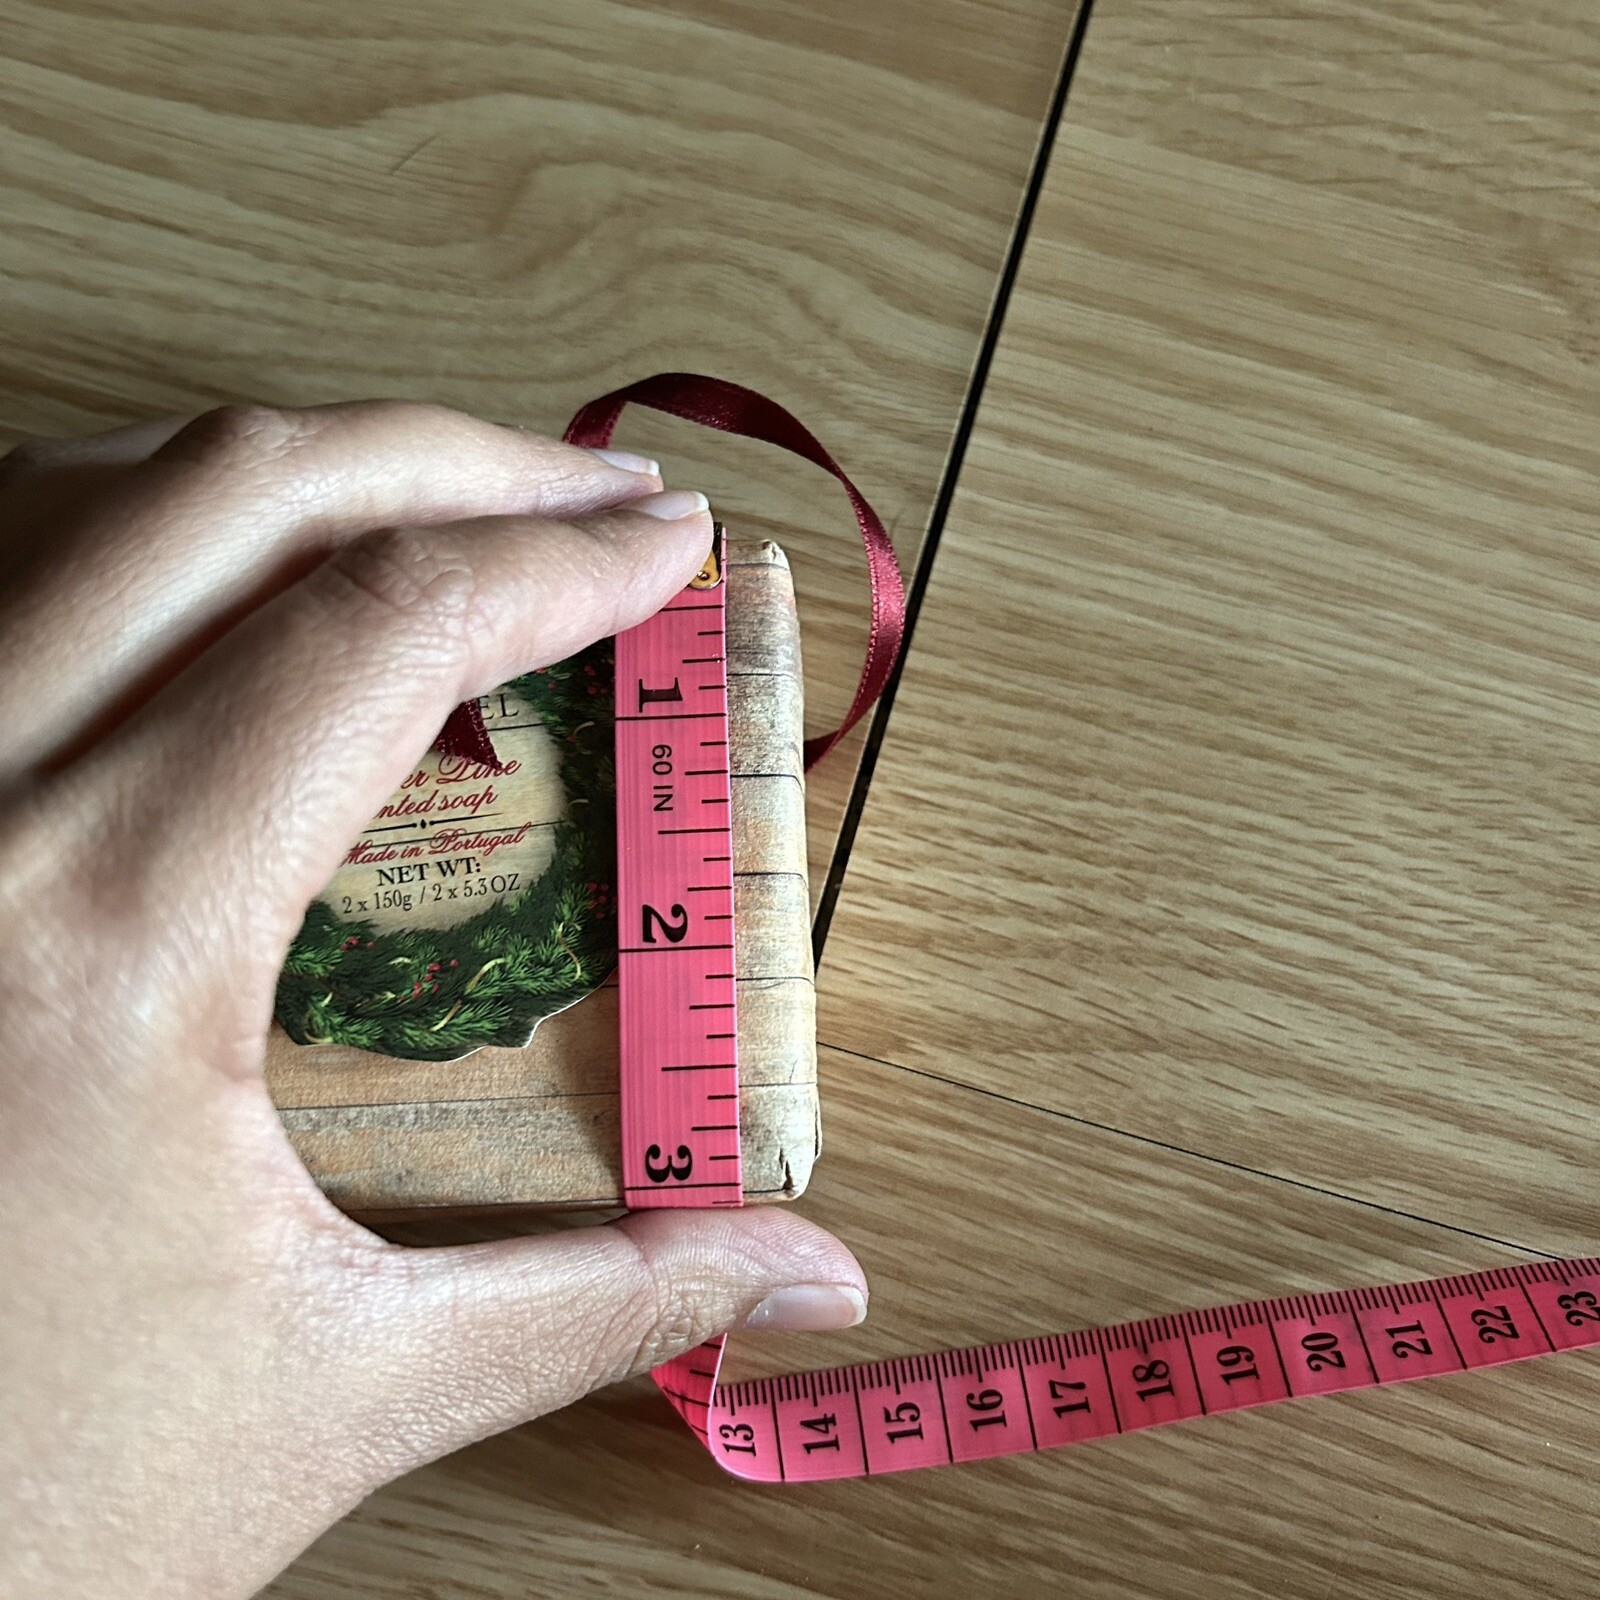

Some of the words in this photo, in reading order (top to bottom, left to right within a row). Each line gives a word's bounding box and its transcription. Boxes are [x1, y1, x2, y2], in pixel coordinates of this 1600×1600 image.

[637, 676, 683, 713] 1
[651, 743, 674, 777] 60
[438, 785, 498, 814] soap
[652, 784, 674, 813] IN
[400, 842, 425, 858] in
[427, 821, 532, 856] Portugal
[376, 863, 430, 887] NET
[436, 857, 481, 877] WT:
[341, 895, 353, 915] 2
[357, 901, 369, 911] x
[373, 889, 414, 911] 150g
[431, 882, 443, 903] 2
[447, 887, 459, 899] x
[641, 903, 688, 943] 2
[644, 1143, 693, 1183] 3
[1470, 1304, 1521, 1345] 22
[1556, 1290, 1600, 1329] 23
[1300, 1331, 1347, 1373] 20
[1384, 1319, 1434, 1360] 21
[1132, 1358, 1176, 1402] 18
[1215, 1345, 1261, 1387] 19
[965, 1388, 1009, 1432] 16
[1048, 1378, 1092, 1419] 17
[718, 1422, 757, 1458] 13
[798, 1413, 842, 1455] 14
[882, 1402, 924, 1445] 15
